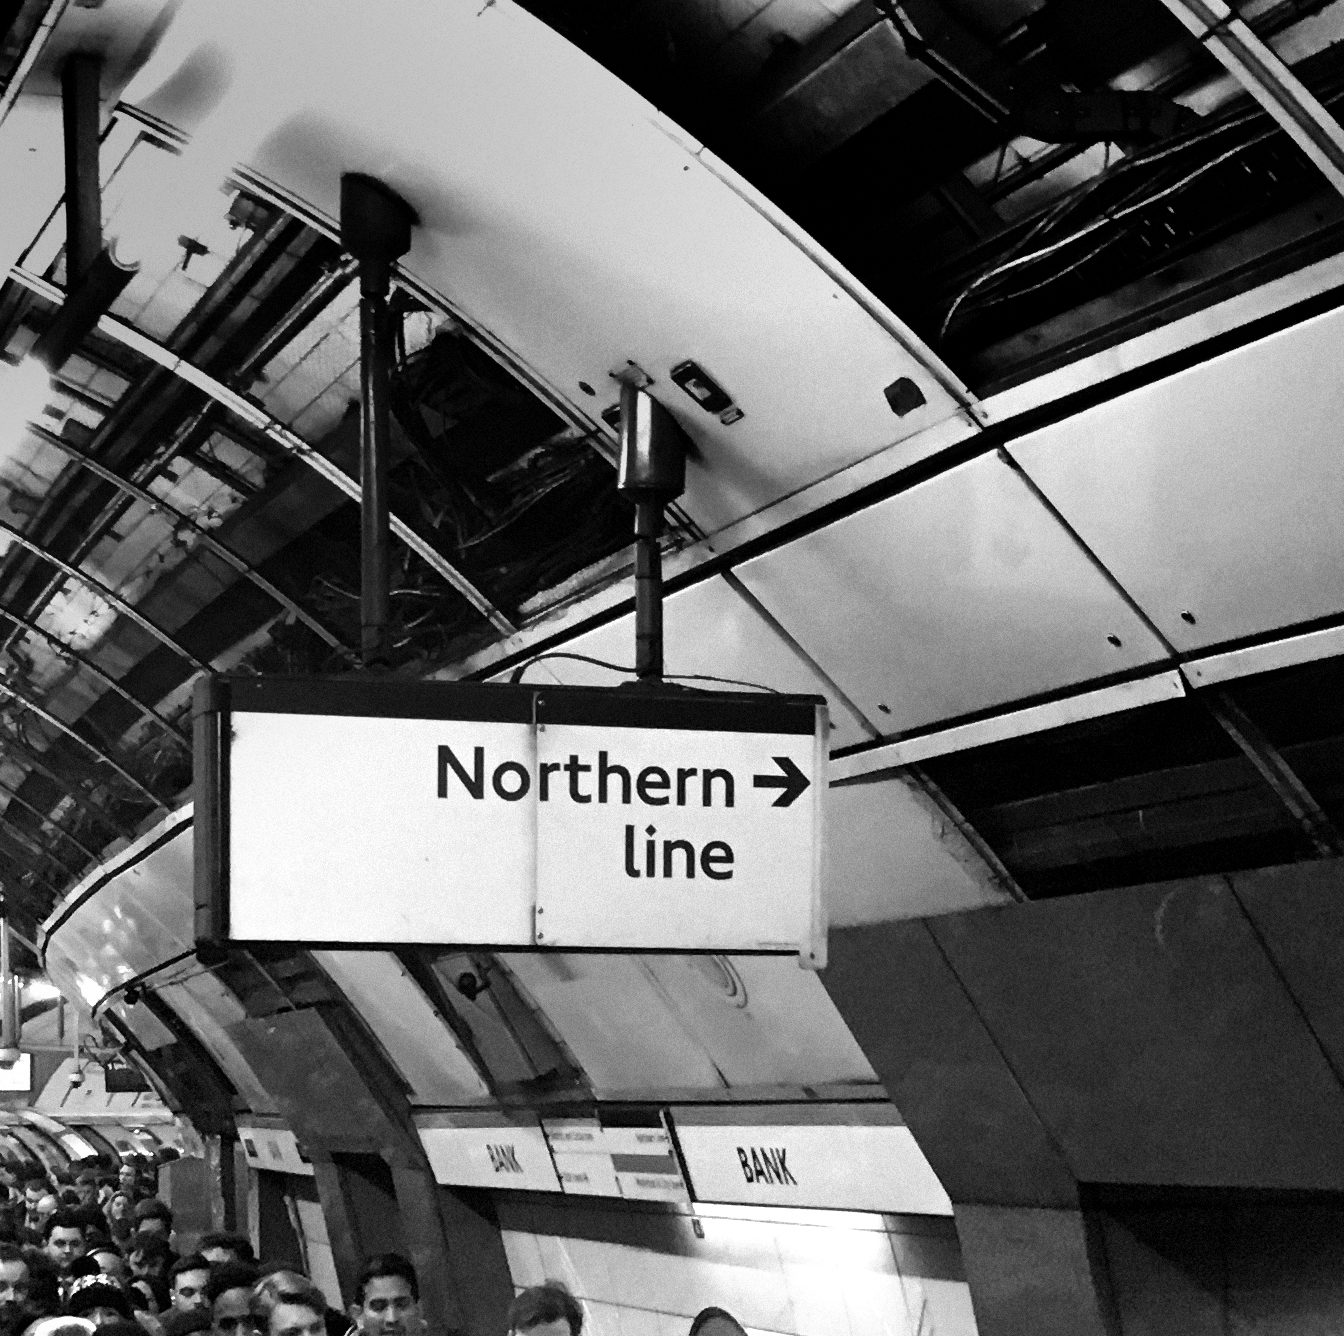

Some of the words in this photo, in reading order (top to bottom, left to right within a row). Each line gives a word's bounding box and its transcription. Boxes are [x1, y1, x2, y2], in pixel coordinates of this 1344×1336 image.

[436, 744, 735, 808] Northern
[624, 824, 735, 881] line
[736, 1146, 797, 1186] BANK
